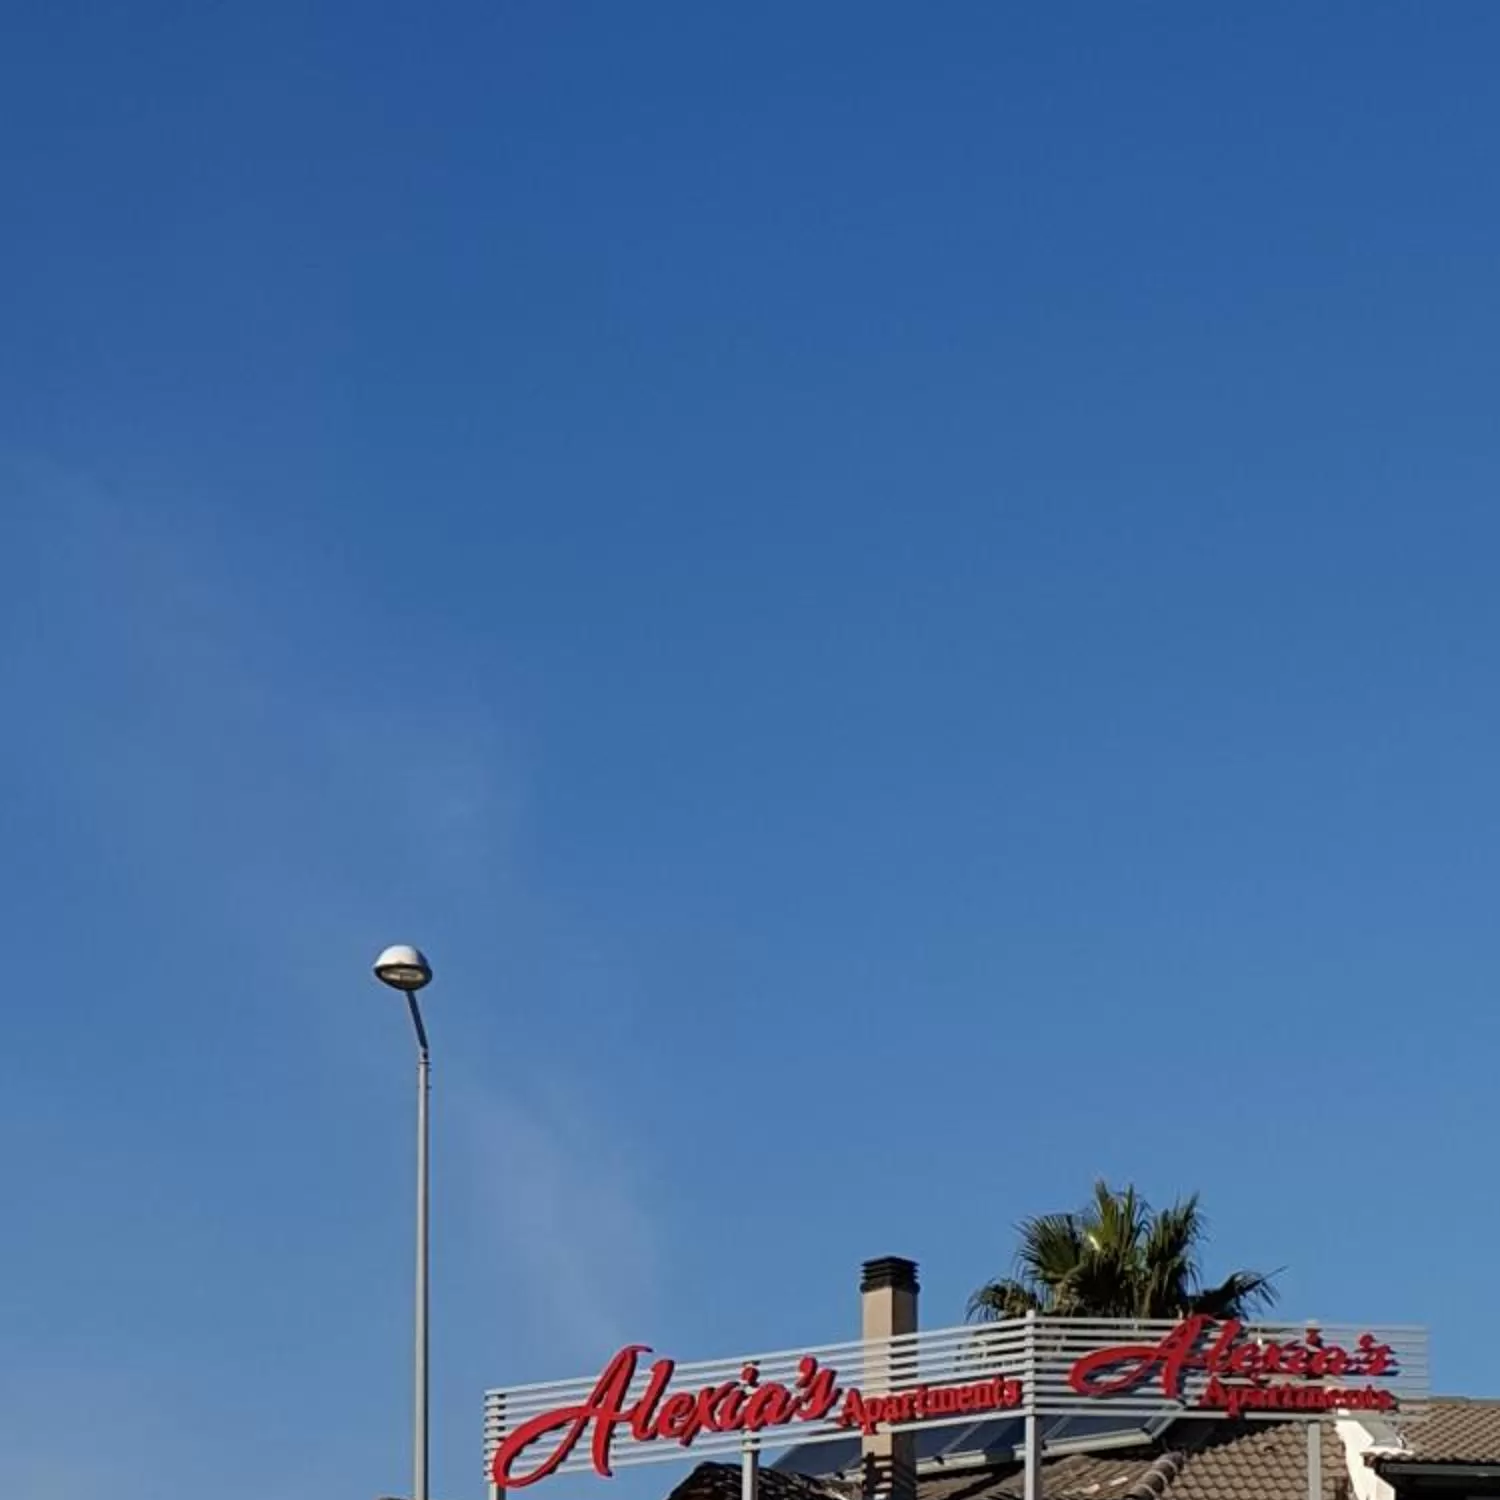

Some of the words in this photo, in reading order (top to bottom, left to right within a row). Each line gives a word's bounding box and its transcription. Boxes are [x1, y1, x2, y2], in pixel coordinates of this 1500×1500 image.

[1068, 1314, 1397, 1398] Alexia's
[491, 1345, 841, 1488] Alexia's
[837, 1376, 1021, 1435] Apartments
